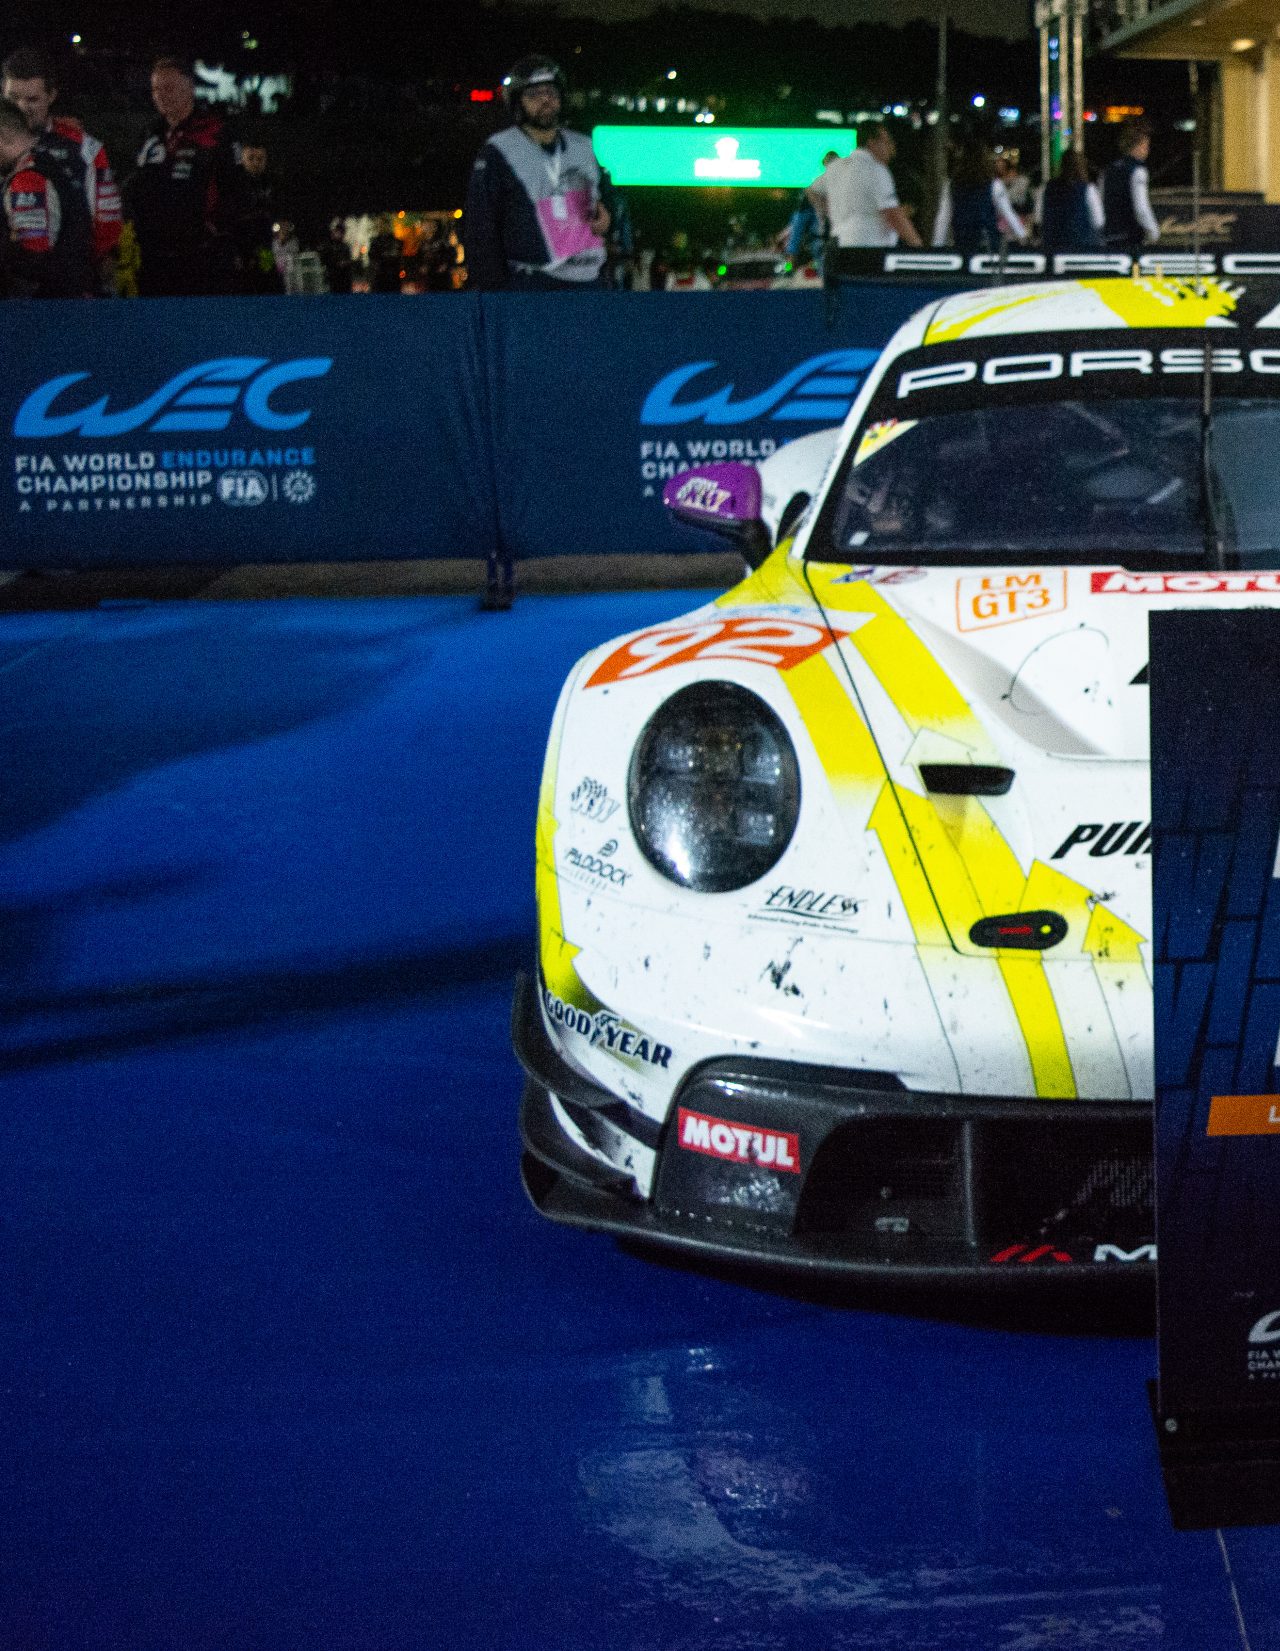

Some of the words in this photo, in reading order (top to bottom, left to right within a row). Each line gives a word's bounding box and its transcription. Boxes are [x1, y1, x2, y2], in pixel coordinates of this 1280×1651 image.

[13, 355, 333, 437] WEC
[640, 348, 883, 426] WE
[14, 453, 57, 474] FIA
[63, 451, 155, 472] WORLD
[161, 446, 317, 469] ENDURANCE
[640, 440, 680, 460] FIA
[686, 438, 777, 459] WORLD
[16, 470, 213, 494] CHAMPIONSHIP
[46, 494, 213, 513] PARTNERSHIP
[982, 573, 1041, 590] LM
[972, 588, 1051, 619] GT3
[617, 621, 824, 679] 92
[765, 885, 860, 916] ENDLESS
[546, 993, 673, 1069] GOODYEAR
[683, 1115, 794, 1167] MOTUL
[1248, 1350, 1269, 1360] FIA
